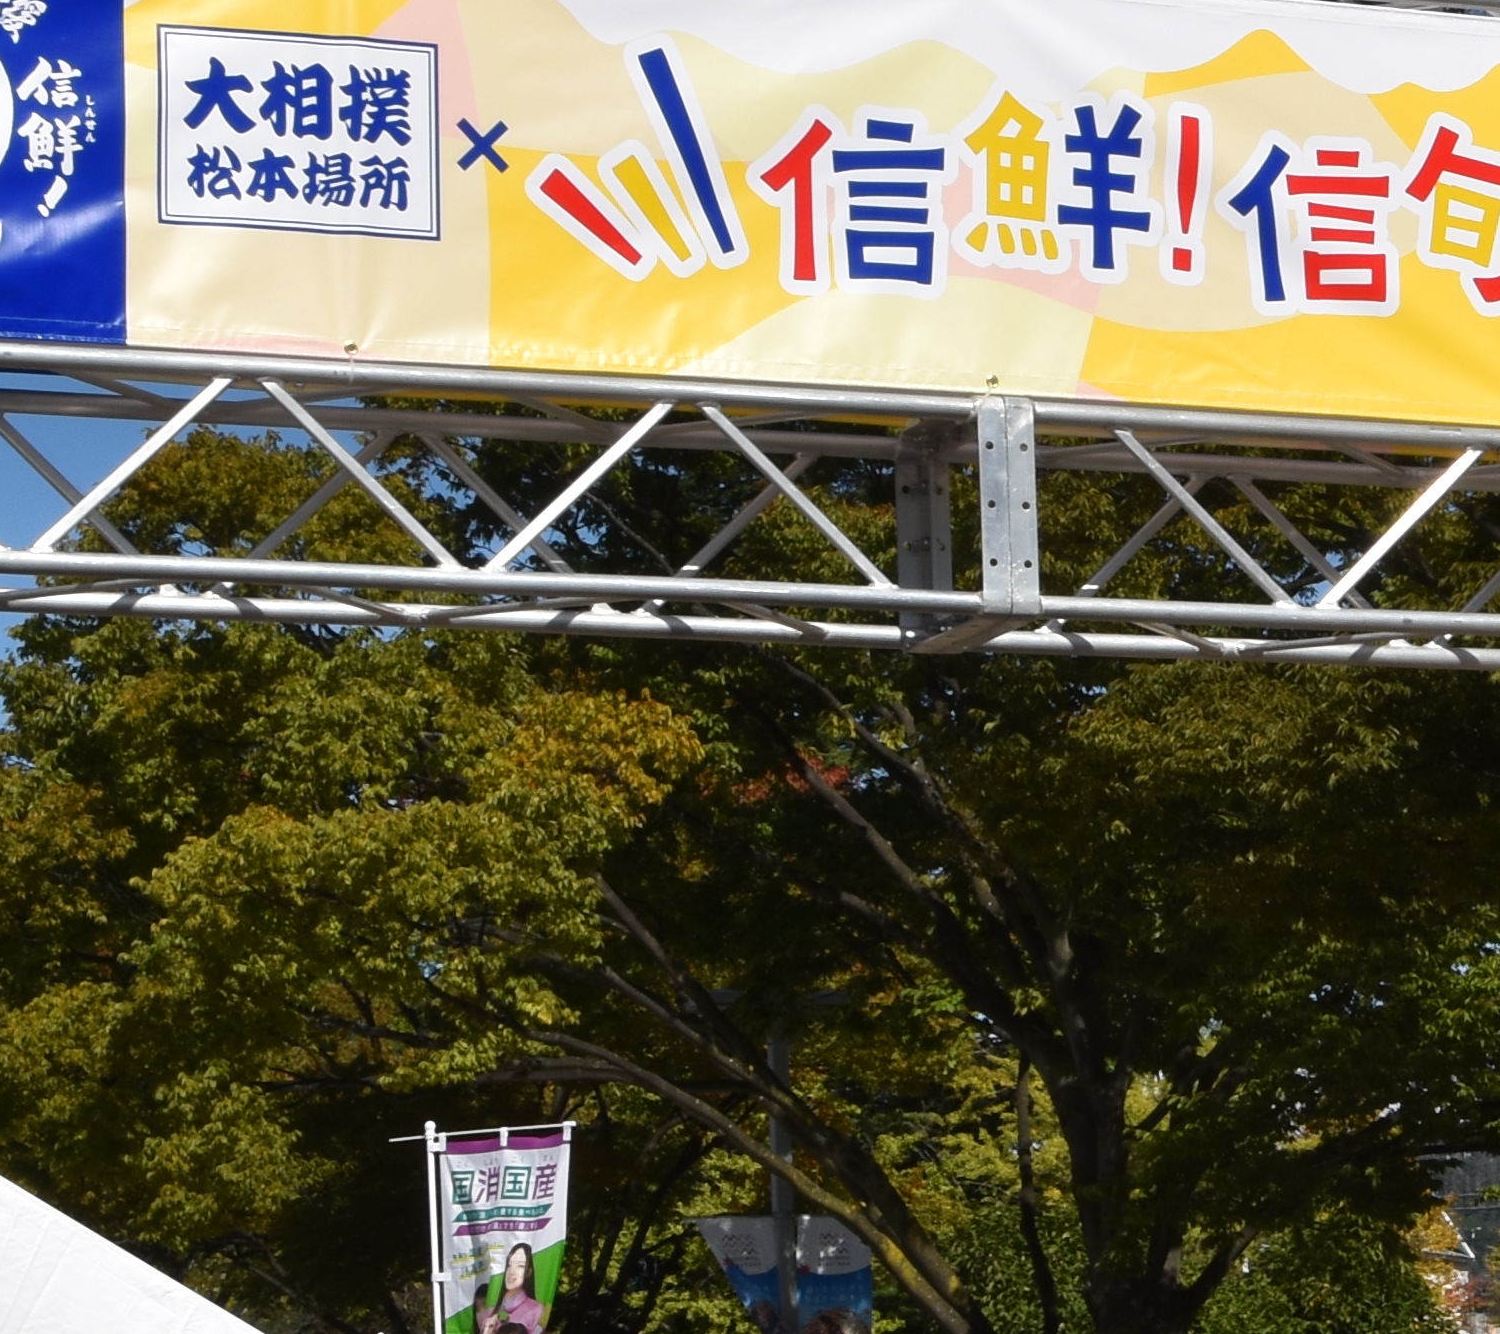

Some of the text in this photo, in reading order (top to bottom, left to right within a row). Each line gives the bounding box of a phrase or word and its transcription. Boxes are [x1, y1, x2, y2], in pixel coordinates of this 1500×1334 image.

[183, 56, 412, 146] 大相撲
[186, 143, 411, 212] 松本場所
[451, 1164, 557, 1205] 国消国産
